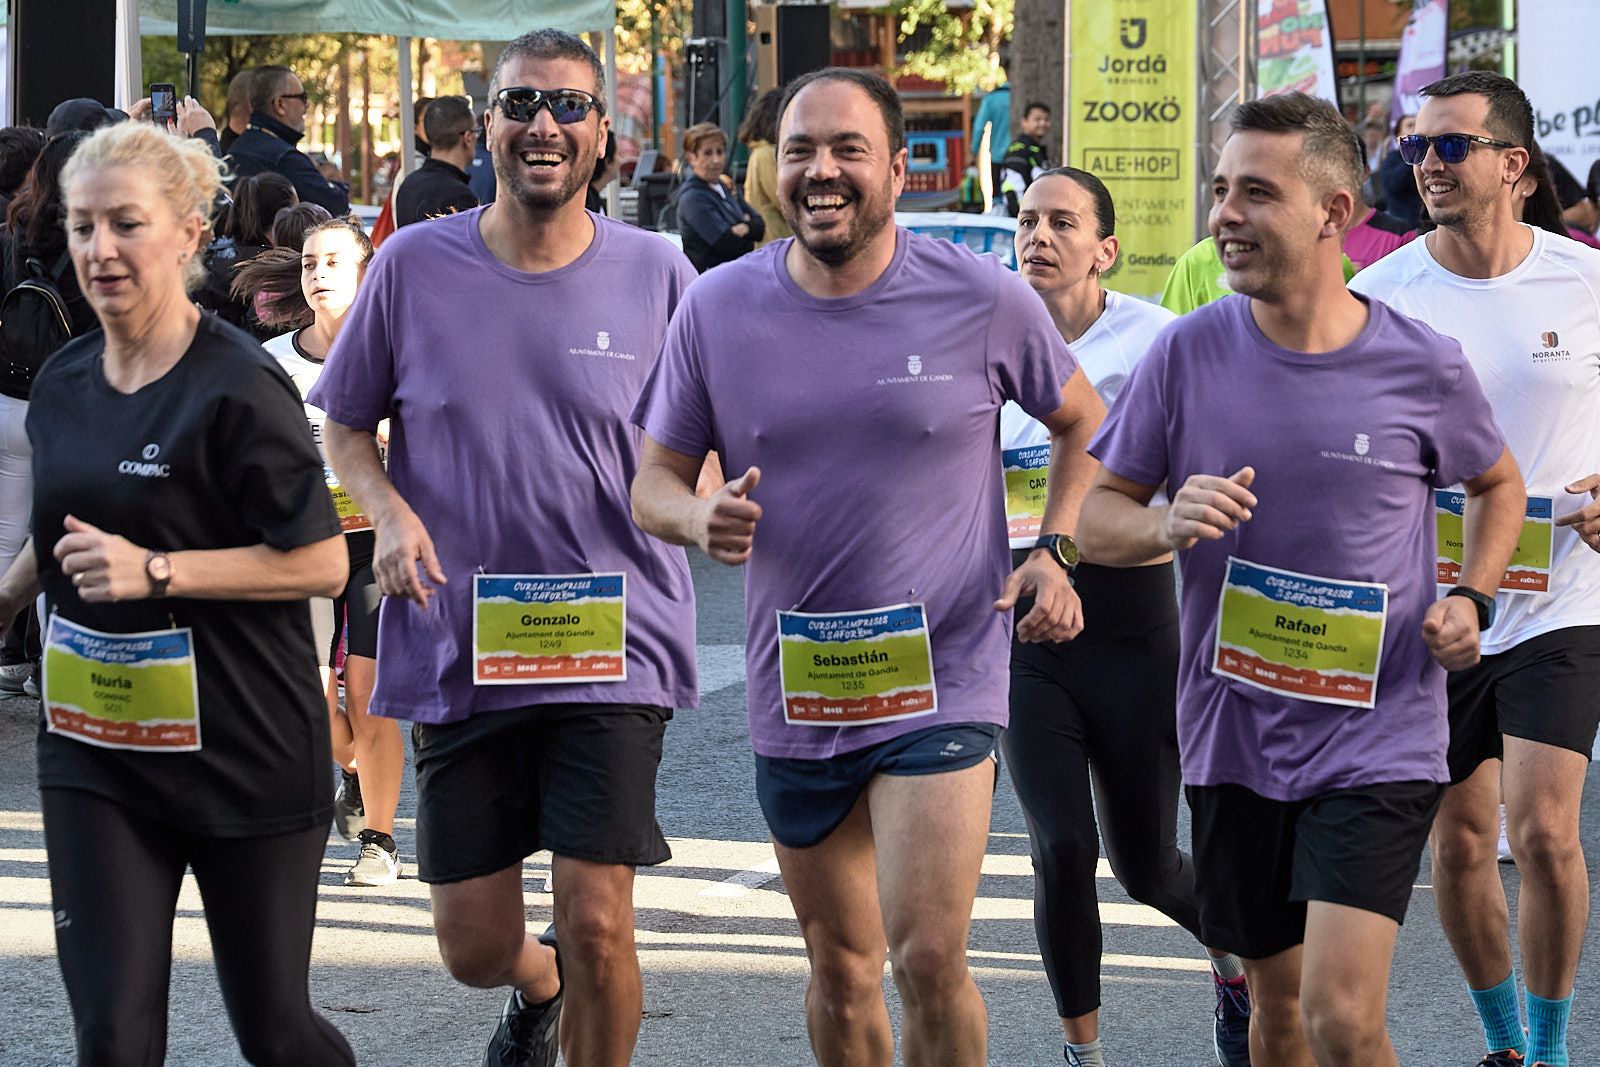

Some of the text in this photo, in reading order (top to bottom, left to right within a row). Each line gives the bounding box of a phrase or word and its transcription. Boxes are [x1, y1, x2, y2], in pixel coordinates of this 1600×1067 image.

[1083, 96, 1181, 122] ZOOKÖ
[1536, 110, 1566, 137] be
[1532, 350, 1571, 358] NORANTA
[520, 613, 580, 627] Gonzalo
[1275, 615, 1328, 636] Rafael
[505, 631, 552, 640] Ajuntament
[1249, 628, 1348, 653] Ajuntament de Gandia
[539, 640, 562, 649] 1249
[813, 650, 889, 667] Sebastián
[1283, 647, 1309, 660] 1234
[807, 666, 900, 680] Ajuntament de Gandia
[90, 672, 133, 689] Nuria
[842, 681, 865, 690] 1235
